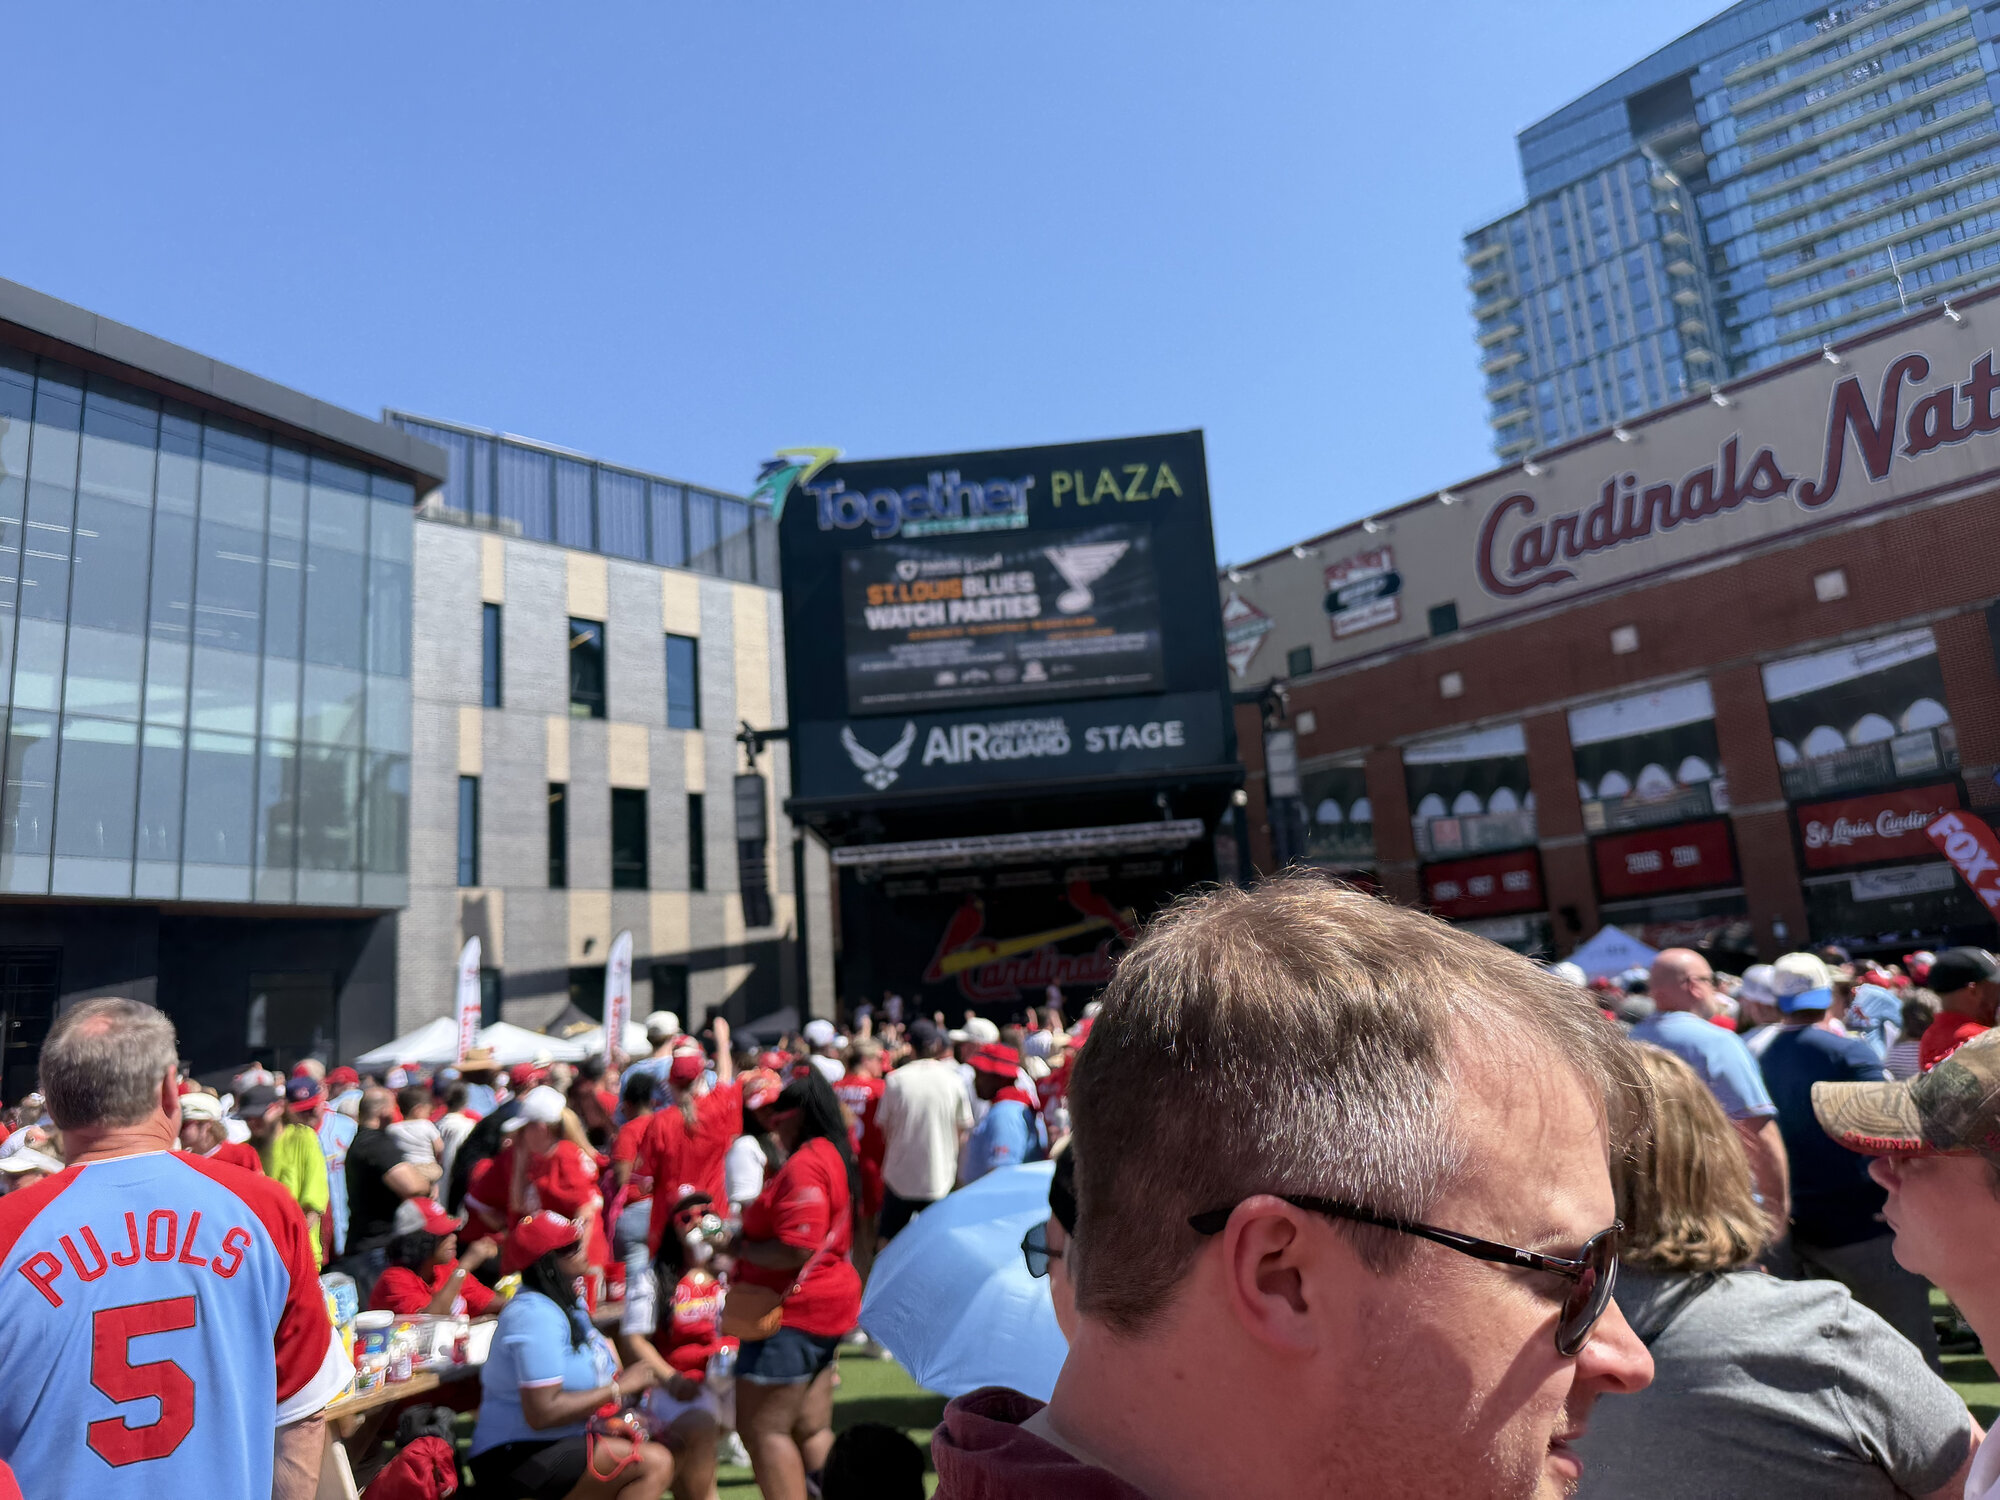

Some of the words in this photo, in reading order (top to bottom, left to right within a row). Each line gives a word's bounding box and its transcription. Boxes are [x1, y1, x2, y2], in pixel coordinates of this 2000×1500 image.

[803, 469, 1035, 539] Together
[1051, 462, 1183, 507] PLAZA
[1478, 430, 1797, 597] Cardinals
[864, 600, 946, 630] WATCH
[948, 593, 1041, 623] PARTIES
[899, 578, 963, 603] LOUIS
[963, 571, 1035, 598] BLUES
[921, 723, 990, 767] AIR
[1085, 720, 1185, 753] STAGE
[988, 717, 1070, 737] NATIONAL
[988, 733, 1072, 761] GUARD
[1829, 817, 1875, 846] Louis
[1876, 806, 1947, 838] Cardin
[1927, 812, 1999, 885] FOX
[959, 937, 1113, 1004] Cardinal
[18, 1209, 252, 1308] PUJOLS
[87, 1295, 198, 1468] 5
